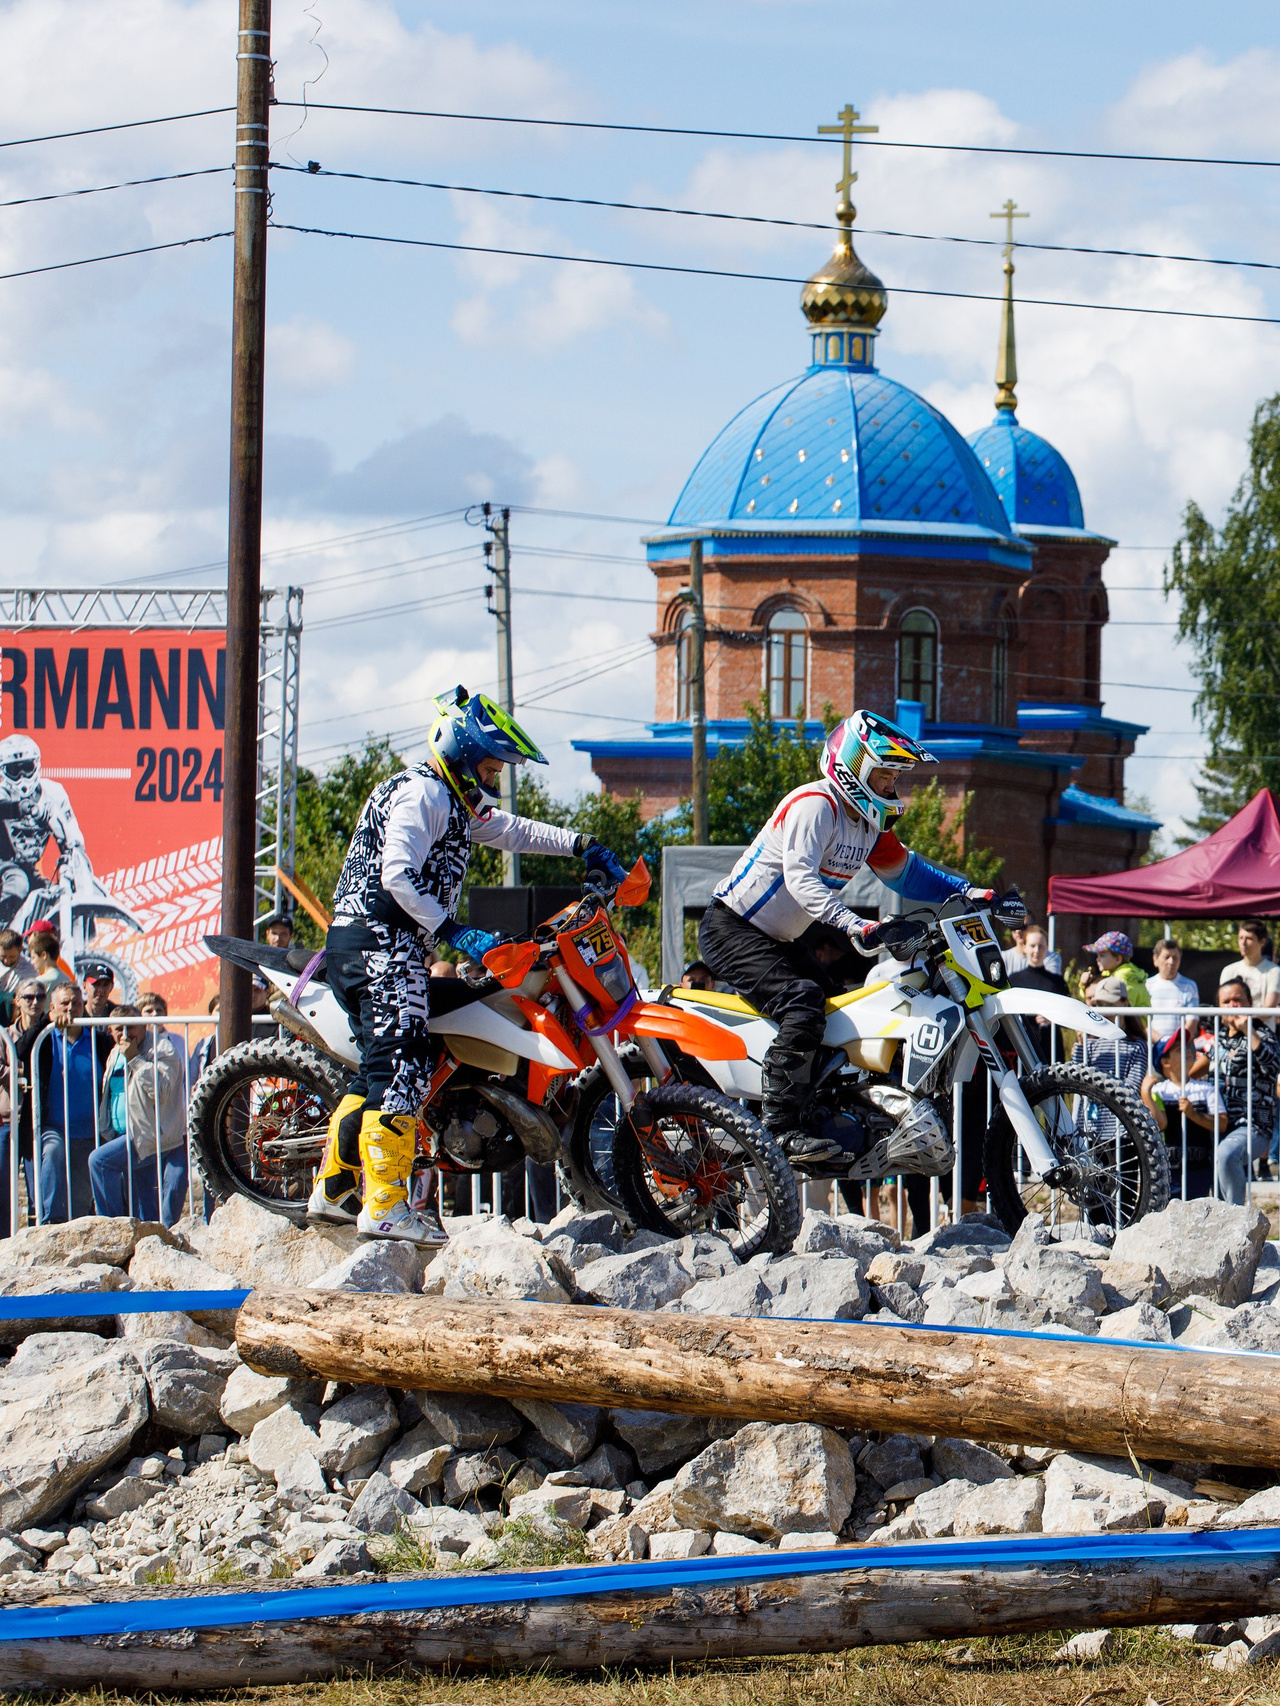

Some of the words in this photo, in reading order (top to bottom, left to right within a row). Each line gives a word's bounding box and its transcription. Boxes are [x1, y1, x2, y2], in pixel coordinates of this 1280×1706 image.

[134, 746, 224, 803] 2024
[832, 762, 873, 804] LEATT
[591, 930, 614, 954] 75
[967, 925, 987, 942] 77
